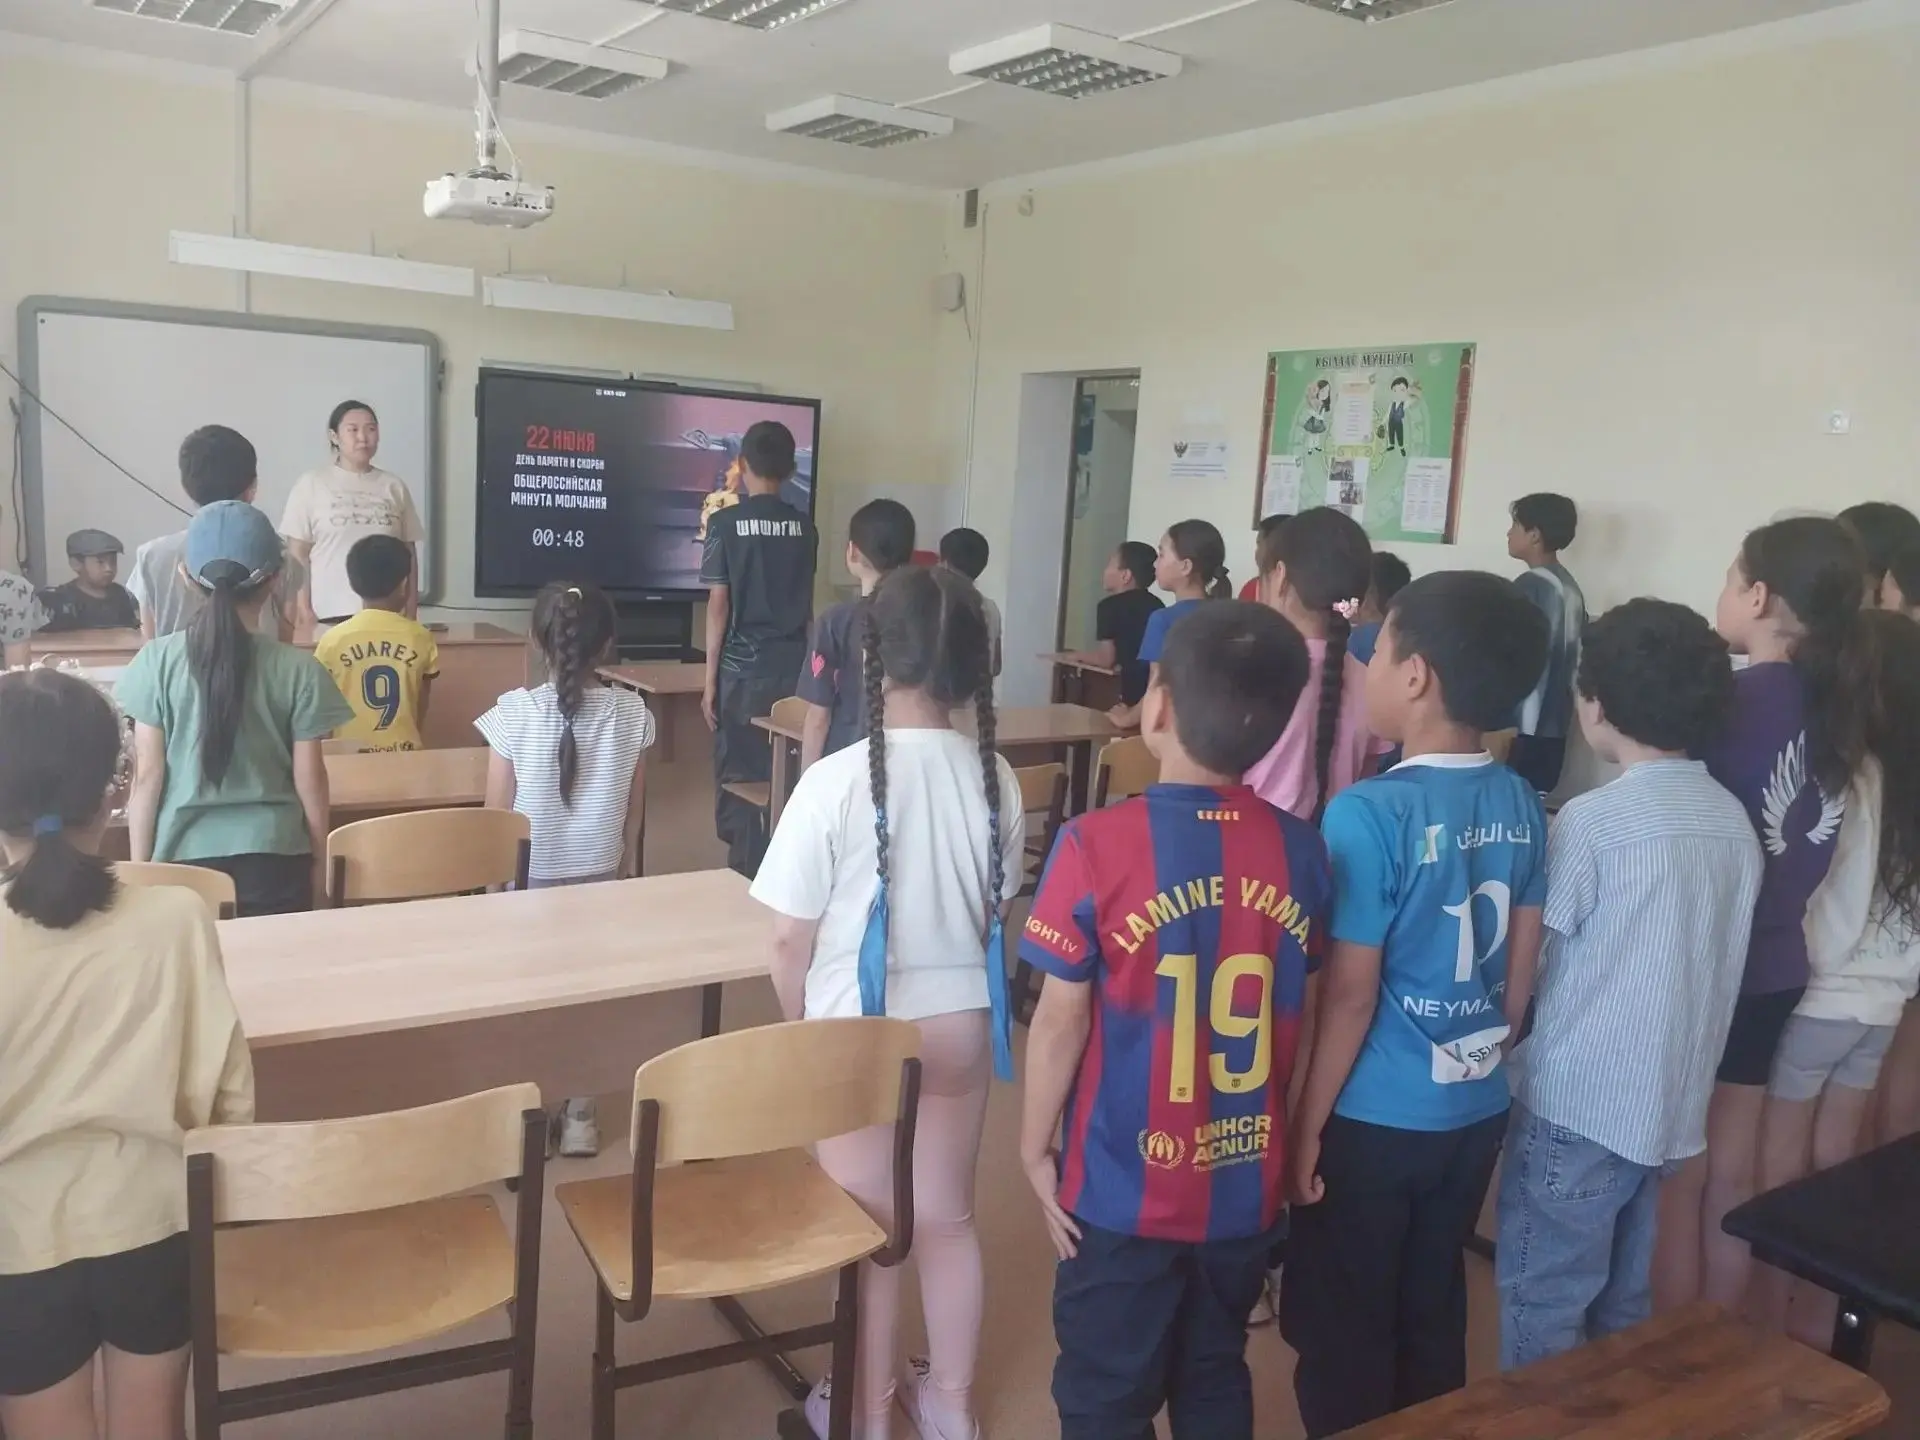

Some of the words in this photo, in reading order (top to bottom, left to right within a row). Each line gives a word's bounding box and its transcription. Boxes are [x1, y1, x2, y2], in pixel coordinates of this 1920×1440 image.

[526, 425, 550, 449] 22
[553, 429, 595, 453] ИЮНЯ
[515, 454, 535, 466] ДЕНЬ
[537, 455, 569, 468] ПАМЯТИ
[570, 457, 575, 469] И
[576, 458, 604, 470] СКОРБИ
[513, 473, 602, 493] ОБЩЕРОССИЙСКАЯ
[510, 491, 553, 507] МИНУТА
[554, 494, 607, 510] МОЛЧАНИЯ
[532, 528, 585, 548] 00:48
[735, 519, 803, 537] ШИШИГИН
[339, 641, 418, 668] SUAREZ
[361, 664, 401, 732] 9
[1111, 875, 1225, 955] LAMINE
[1240, 876, 1310, 955] YAMA
[1025, 915, 1061, 944] IGHT
[1403, 995, 1494, 1019] NEYMA
[1154, 953, 1275, 1103] 19
[1194, 1114, 1272, 1145] UNHCR
[1191, 1133, 1270, 1165] ACNUR
